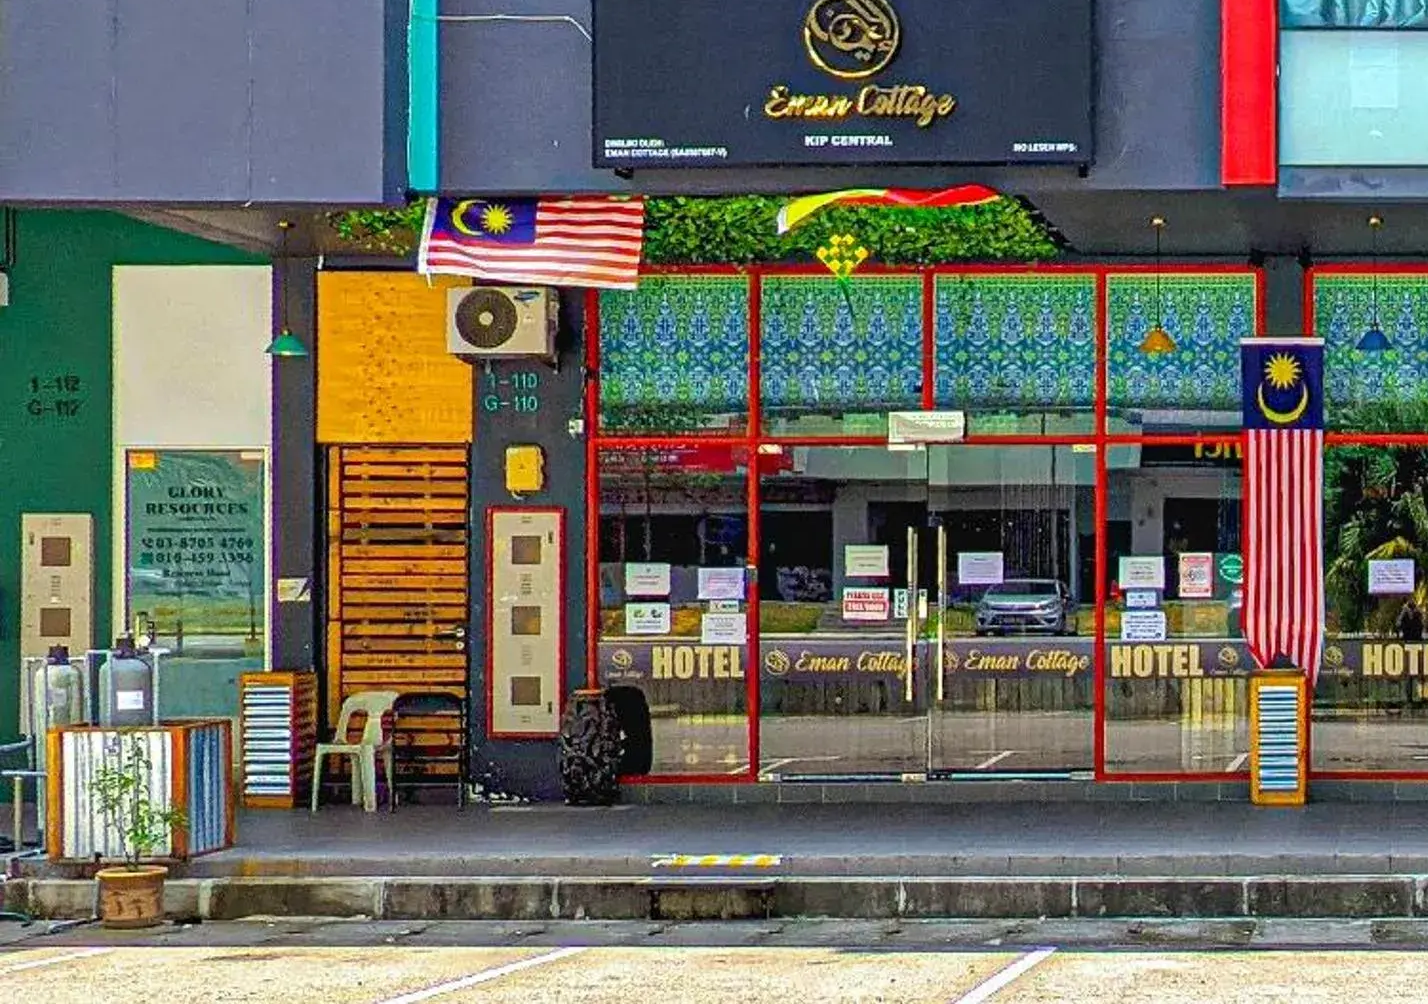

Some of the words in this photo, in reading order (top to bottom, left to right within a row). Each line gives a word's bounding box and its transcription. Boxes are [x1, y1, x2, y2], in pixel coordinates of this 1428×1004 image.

[764, 84, 853, 118] Eman
[856, 83, 956, 128] Cottage
[804, 135, 829, 146] KIP
[830, 135, 893, 146] CENTRAL
[488, 372, 539, 388] 1-110
[483, 394, 539, 412] G-110
[167, 486, 224, 498] GLORY
[145, 502, 249, 515] RESOURCES
[652, 646, 746, 679] HOTEL
[795, 650, 850, 672] Eman
[964, 649, 1021, 671] Eman
[1025, 649, 1091, 678] Cottage
[1111, 644, 1204, 678] HOTEL
